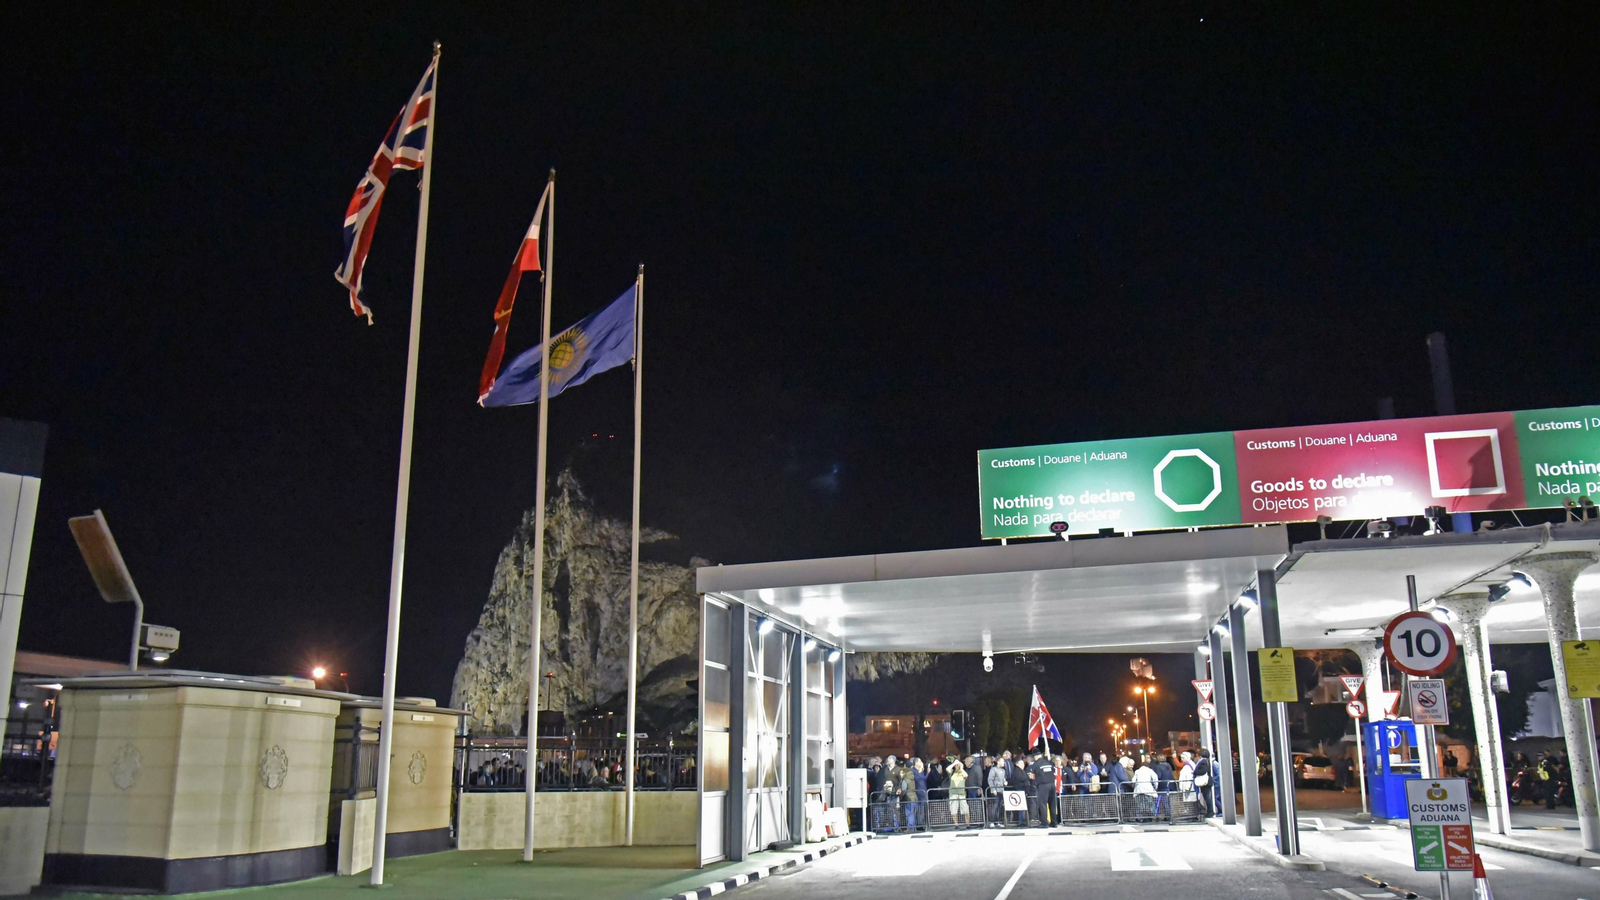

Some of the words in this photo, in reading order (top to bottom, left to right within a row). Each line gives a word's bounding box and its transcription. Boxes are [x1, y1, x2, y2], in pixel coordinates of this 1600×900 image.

[1528, 420, 1582, 431] Customs
[1246, 439, 1296, 450] Customs
[1305, 434, 1346, 447] Douane
[1356, 431, 1398, 444] Aduana
[991, 457, 1035, 468] Customs
[1044, 452, 1082, 465] Douane
[1090, 450, 1128, 462] Aduana
[1251, 476, 1304, 494] Goods
[1308, 475, 1327, 490] to
[1331, 472, 1394, 489] declare
[1538, 479, 1581, 495] Nada
[993, 494, 1054, 510] Nothing
[1058, 493, 1075, 506] to
[1080, 489, 1136, 505] declare
[1252, 495, 1310, 514] Objetos
[1313, 493, 1347, 510] para
[993, 512, 1029, 527] Nada
[1034, 512, 1064, 527] para
[1068, 508, 1122, 522] declarar
[1398, 629, 1441, 658] 10
[1411, 803, 1467, 813] CUSTOMS
[1420, 814, 1461, 822] ADUANA
